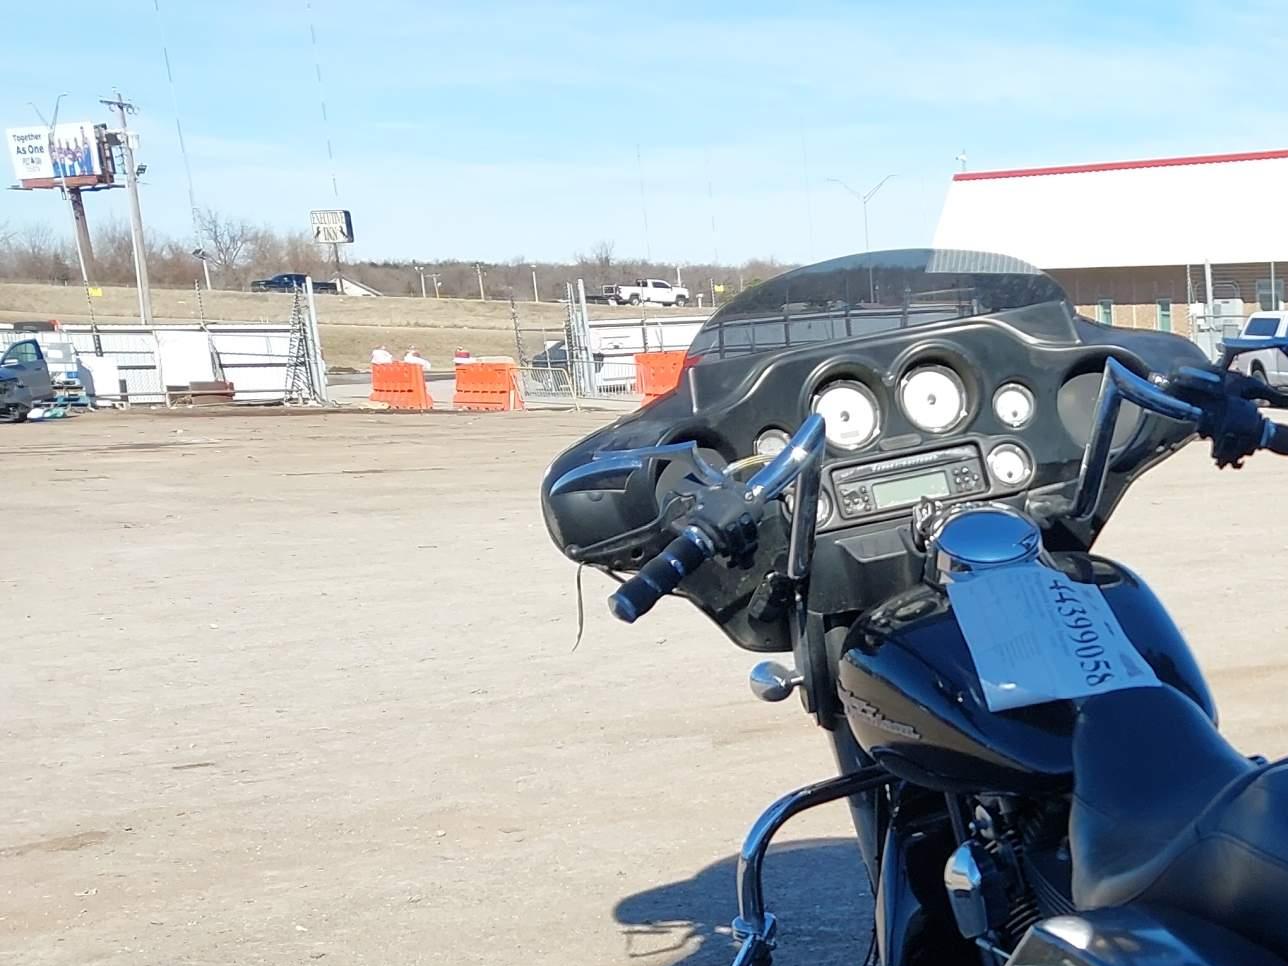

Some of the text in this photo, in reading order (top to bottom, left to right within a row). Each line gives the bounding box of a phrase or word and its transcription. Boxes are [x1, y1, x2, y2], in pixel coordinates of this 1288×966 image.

[12, 133, 41, 143] Together
[16, 144, 44, 155] As One
[312, 211, 345, 225] EXECUTIVE
[323, 226, 338, 241] INN
[1047, 578, 1115, 688] 44399058
